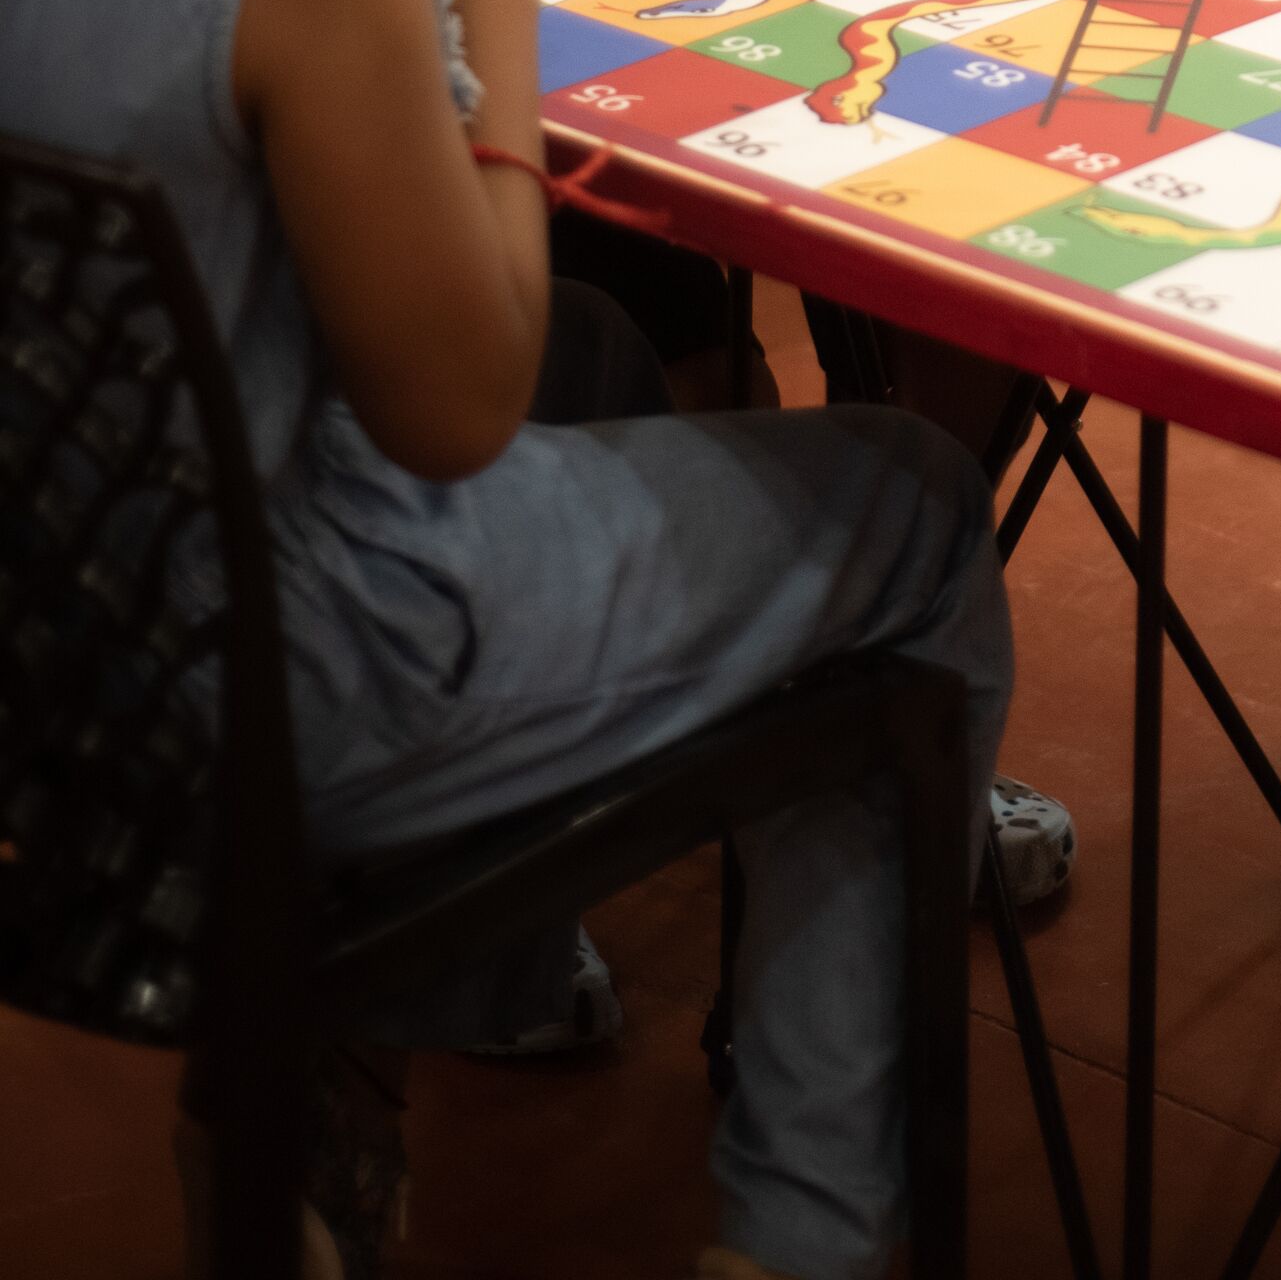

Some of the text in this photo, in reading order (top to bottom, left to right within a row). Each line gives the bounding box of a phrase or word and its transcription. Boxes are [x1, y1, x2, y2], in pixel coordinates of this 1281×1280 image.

[709, 35, 782, 62] 86
[975, 34, 1041, 59] 76
[953, 60, 1026, 88] 85
[570, 84, 644, 112] 95
[709, 130, 780, 159] 96
[1044, 142, 1121, 173] 84
[847, 178, 917, 209] 97
[1132, 173, 1204, 199] 83
[988, 224, 1066, 258] 98
[1155, 284, 1230, 313] 99
